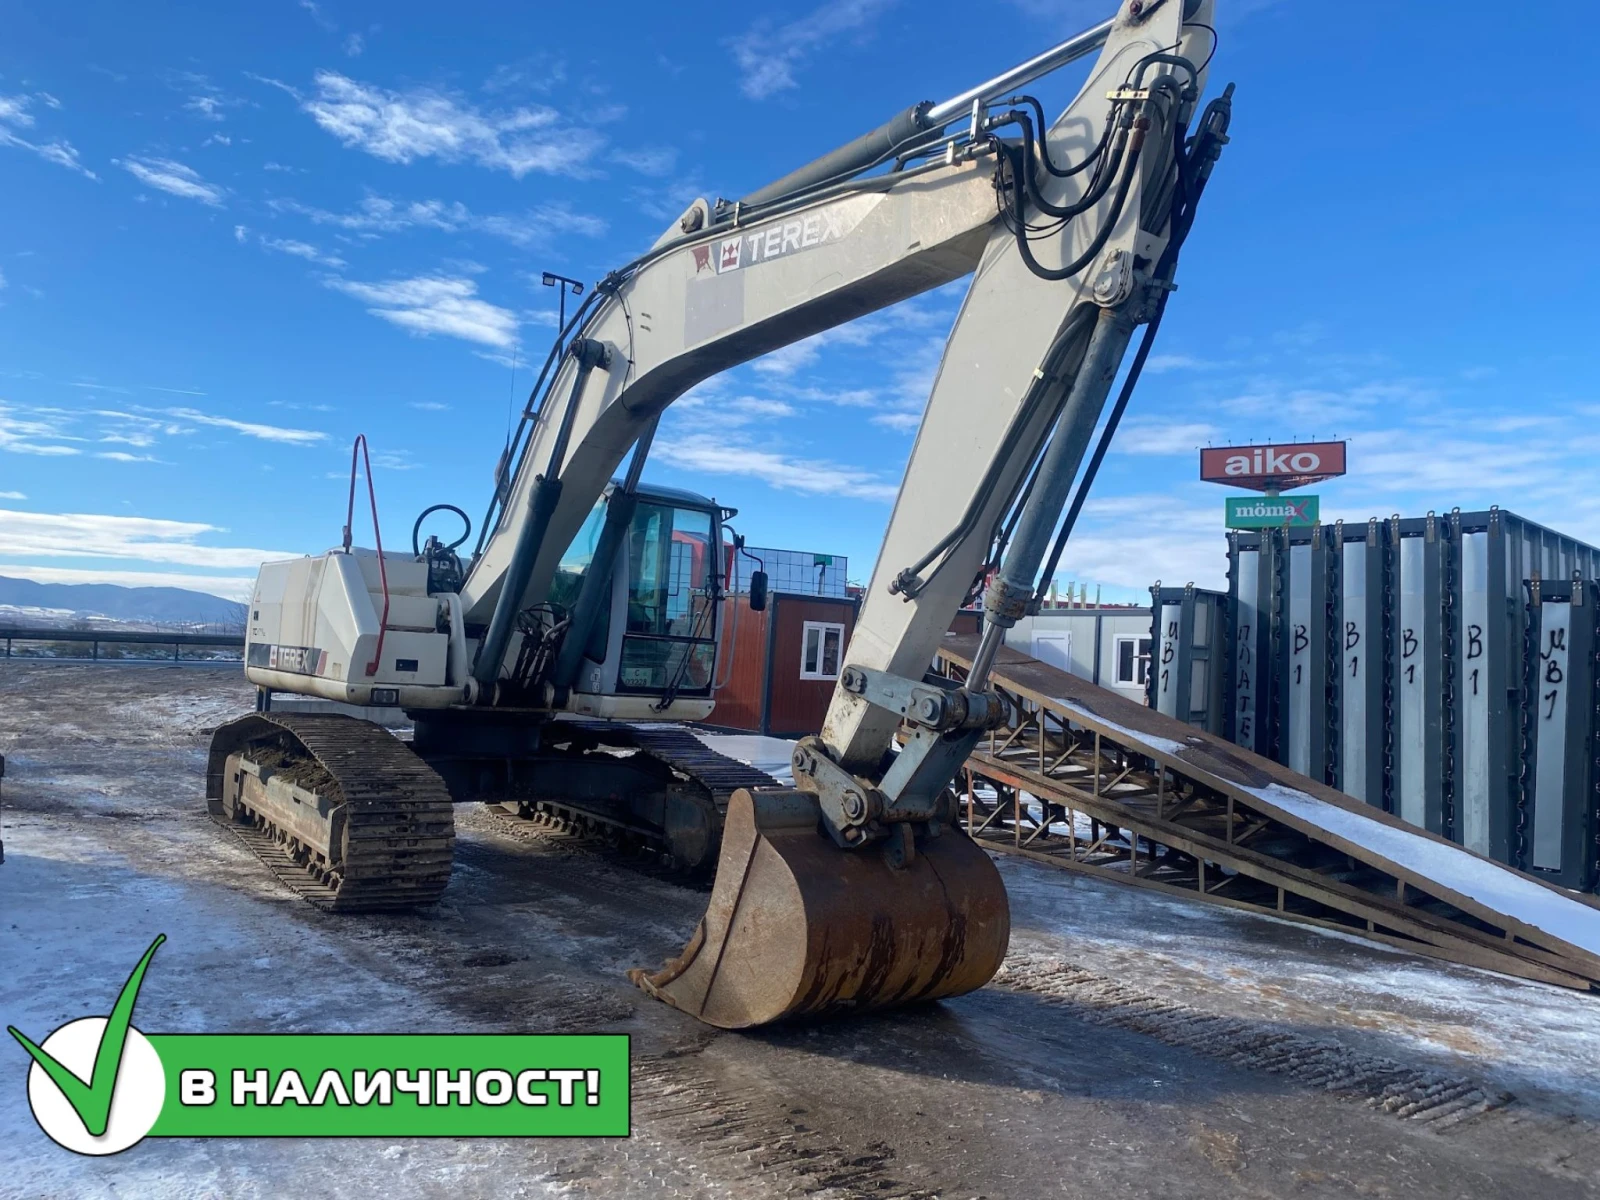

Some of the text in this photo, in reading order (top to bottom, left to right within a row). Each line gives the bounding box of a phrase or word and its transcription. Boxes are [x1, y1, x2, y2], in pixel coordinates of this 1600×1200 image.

[749, 206, 843, 262] TEREX
[1225, 449, 1320, 475] aiko
[279, 647, 309, 671] TEREX
